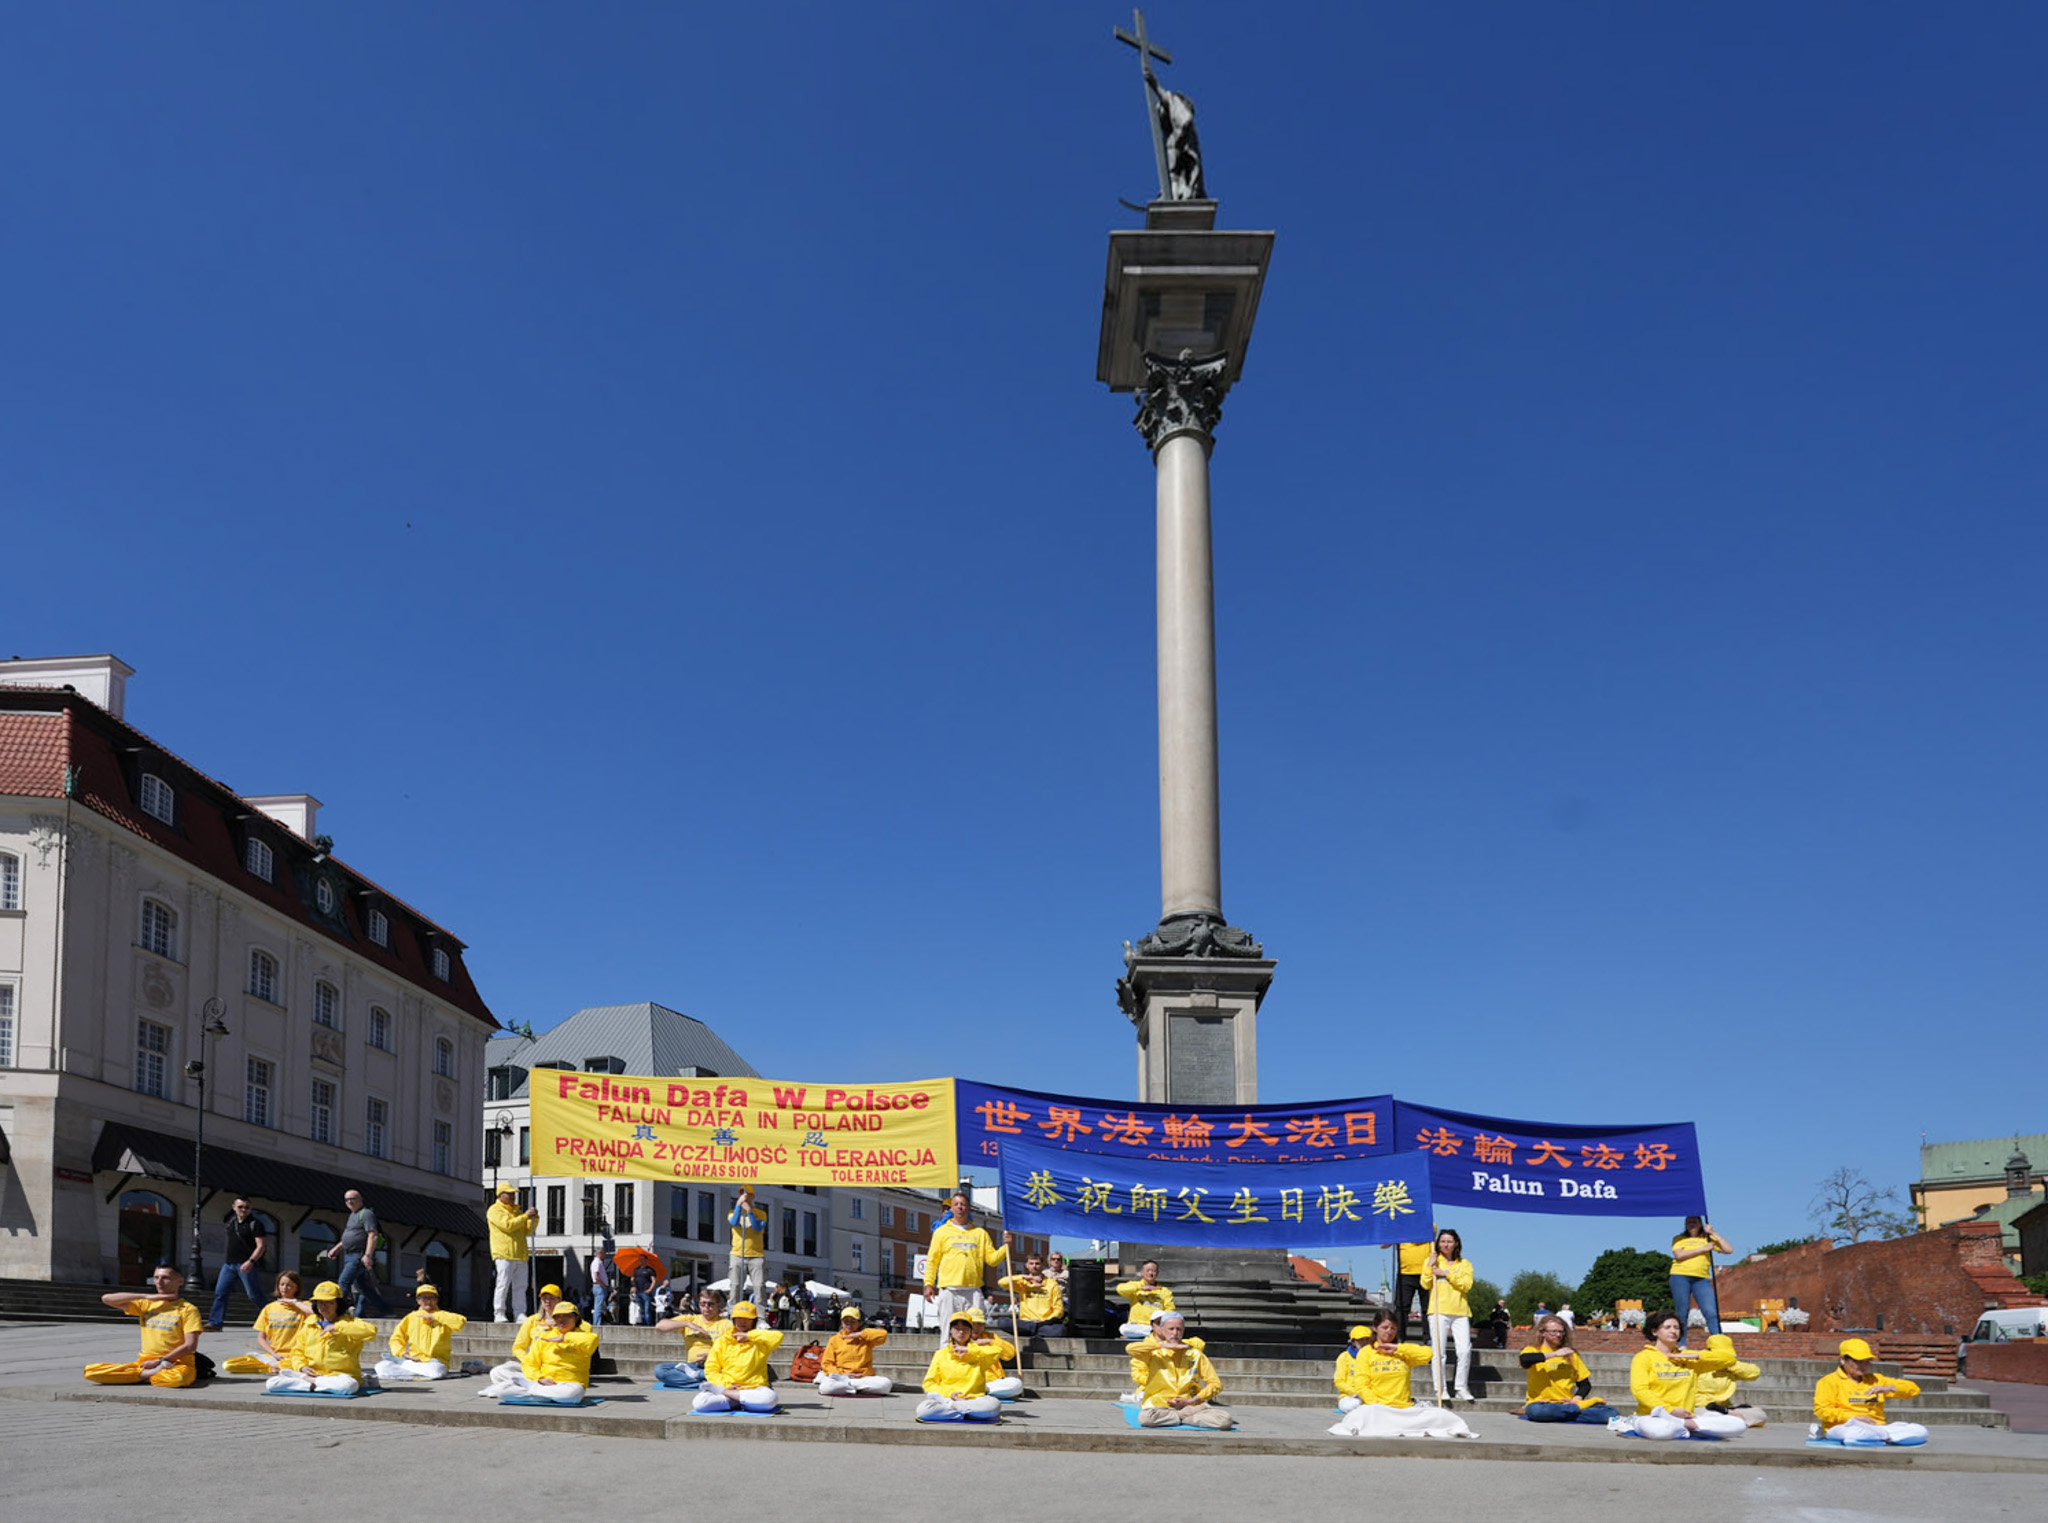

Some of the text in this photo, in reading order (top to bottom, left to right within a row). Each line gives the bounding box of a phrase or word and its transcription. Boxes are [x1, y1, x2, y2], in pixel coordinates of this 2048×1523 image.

[559, 1075, 930, 1111] Falun Dafa W Polsce
[597, 1104, 883, 1131] FALUN DAFA IN POLAND
[975, 1099, 1376, 1149] 世界法輪大法日
[631, 1124, 658, 1141] 真
[710, 1127, 739, 1147] 善
[1416, 1127, 1676, 1170] 法輪大法好
[555, 1137, 937, 1168] PRAWDA ŻYCZLIWOŚĆ TOLERANCJA
[580, 1158, 908, 1184] TRUTH COMPASSION TOLERANCE
[1472, 1171, 1619, 1200] Falun Dafa
[1021, 1170, 1416, 1225] 恭祝師父生日快樂
